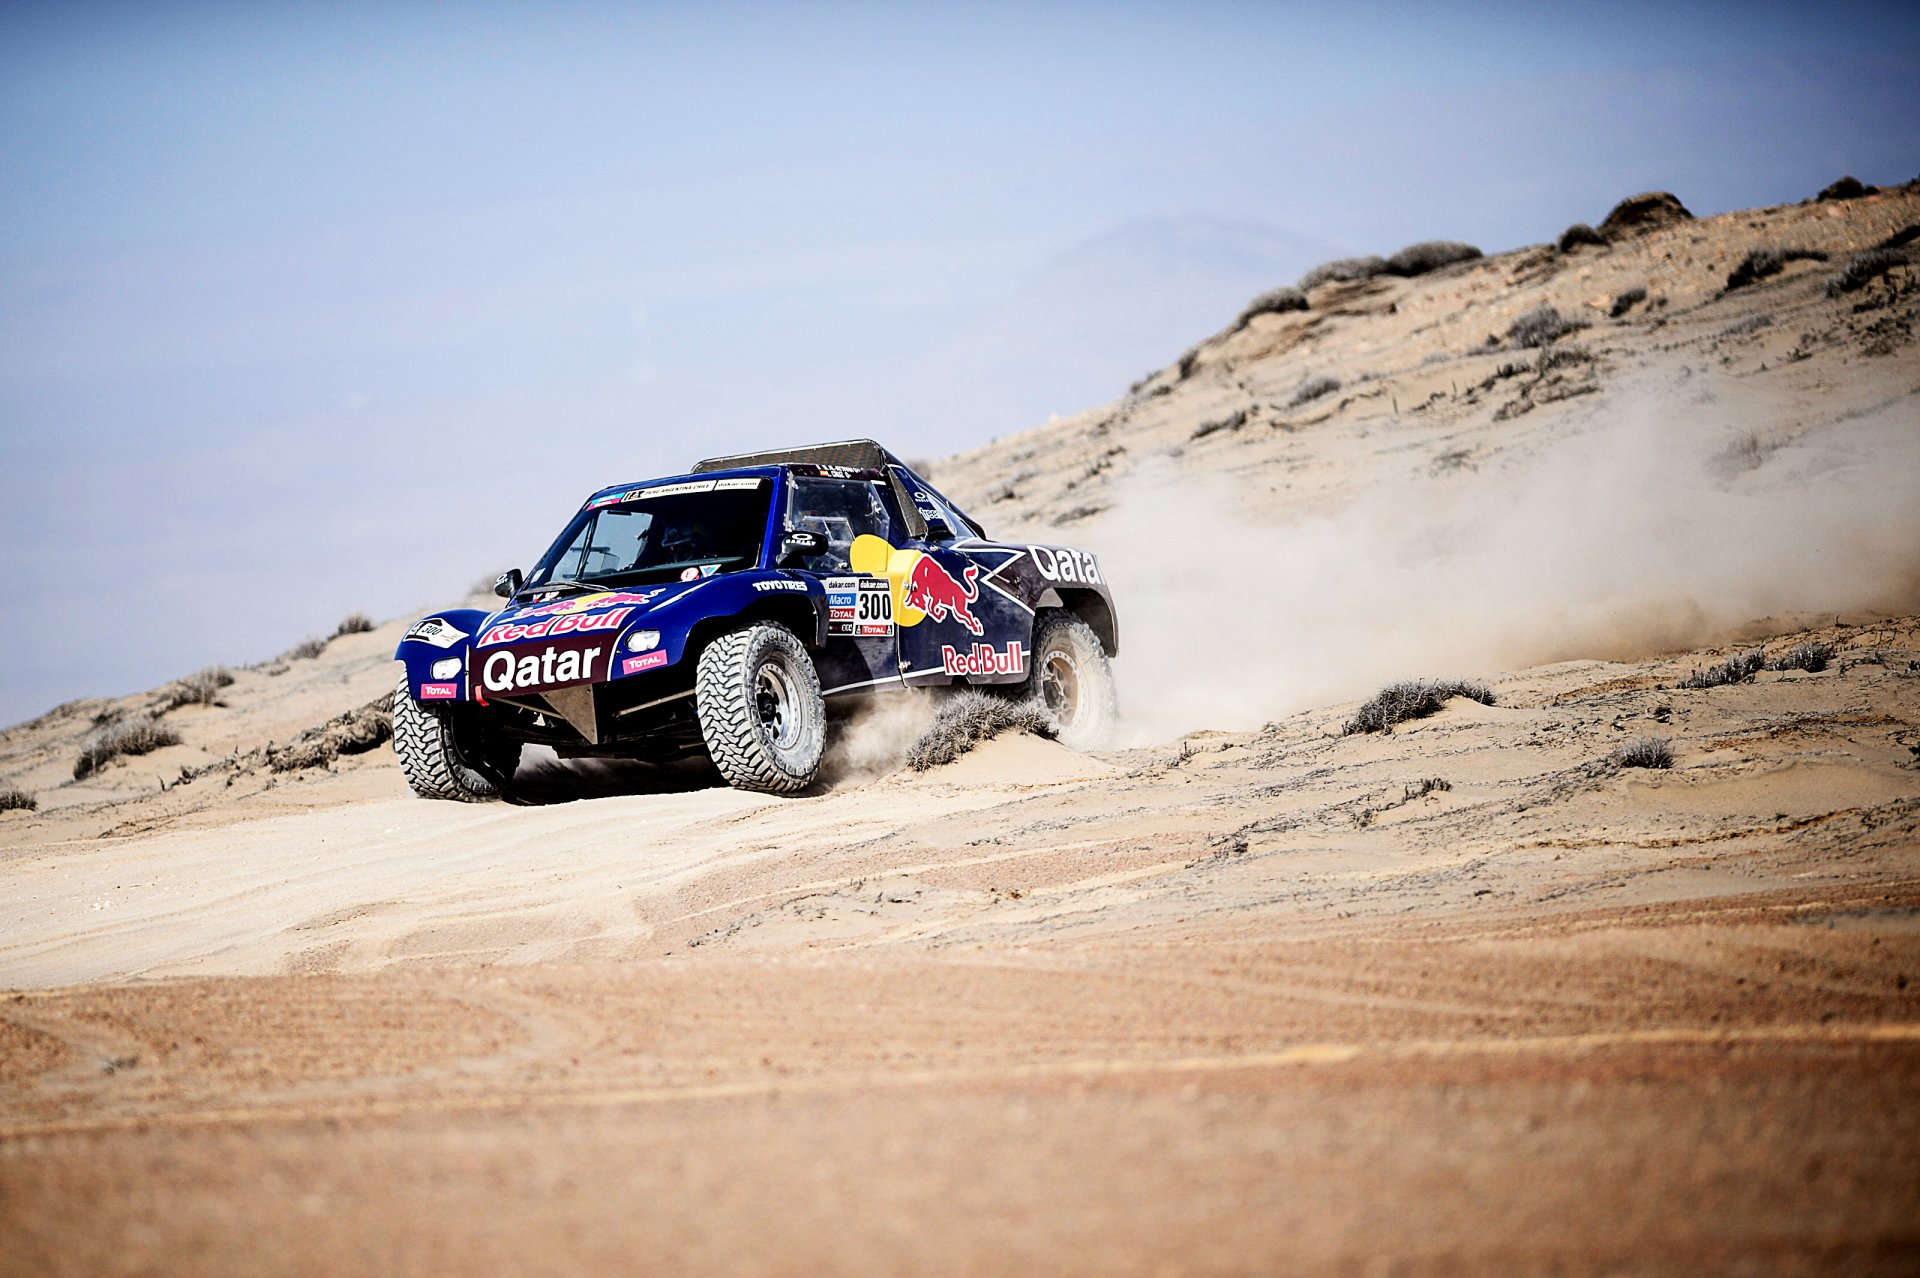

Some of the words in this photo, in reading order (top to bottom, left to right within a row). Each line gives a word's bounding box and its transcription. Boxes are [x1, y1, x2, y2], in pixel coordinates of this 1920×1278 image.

[661, 485, 692, 493] ARGENTINA
[752, 580, 781, 591] TOYO
[780, 580, 808, 591] TIRES
[828, 581, 855, 589] dakar.com
[860, 580, 889, 589] dakar.com
[829, 594, 852, 605] Macro
[859, 593, 892, 620] 300
[829, 609, 854, 618] TOTAL
[478, 615, 559, 647] Red
[551, 607, 633, 634] Bull
[628, 656, 661, 669] TOTAL
[943, 644, 979, 674] Red
[981, 642, 1022, 673] Bull
[483, 646, 601, 691] Qatar
[425, 686, 452, 695] TOTAL
